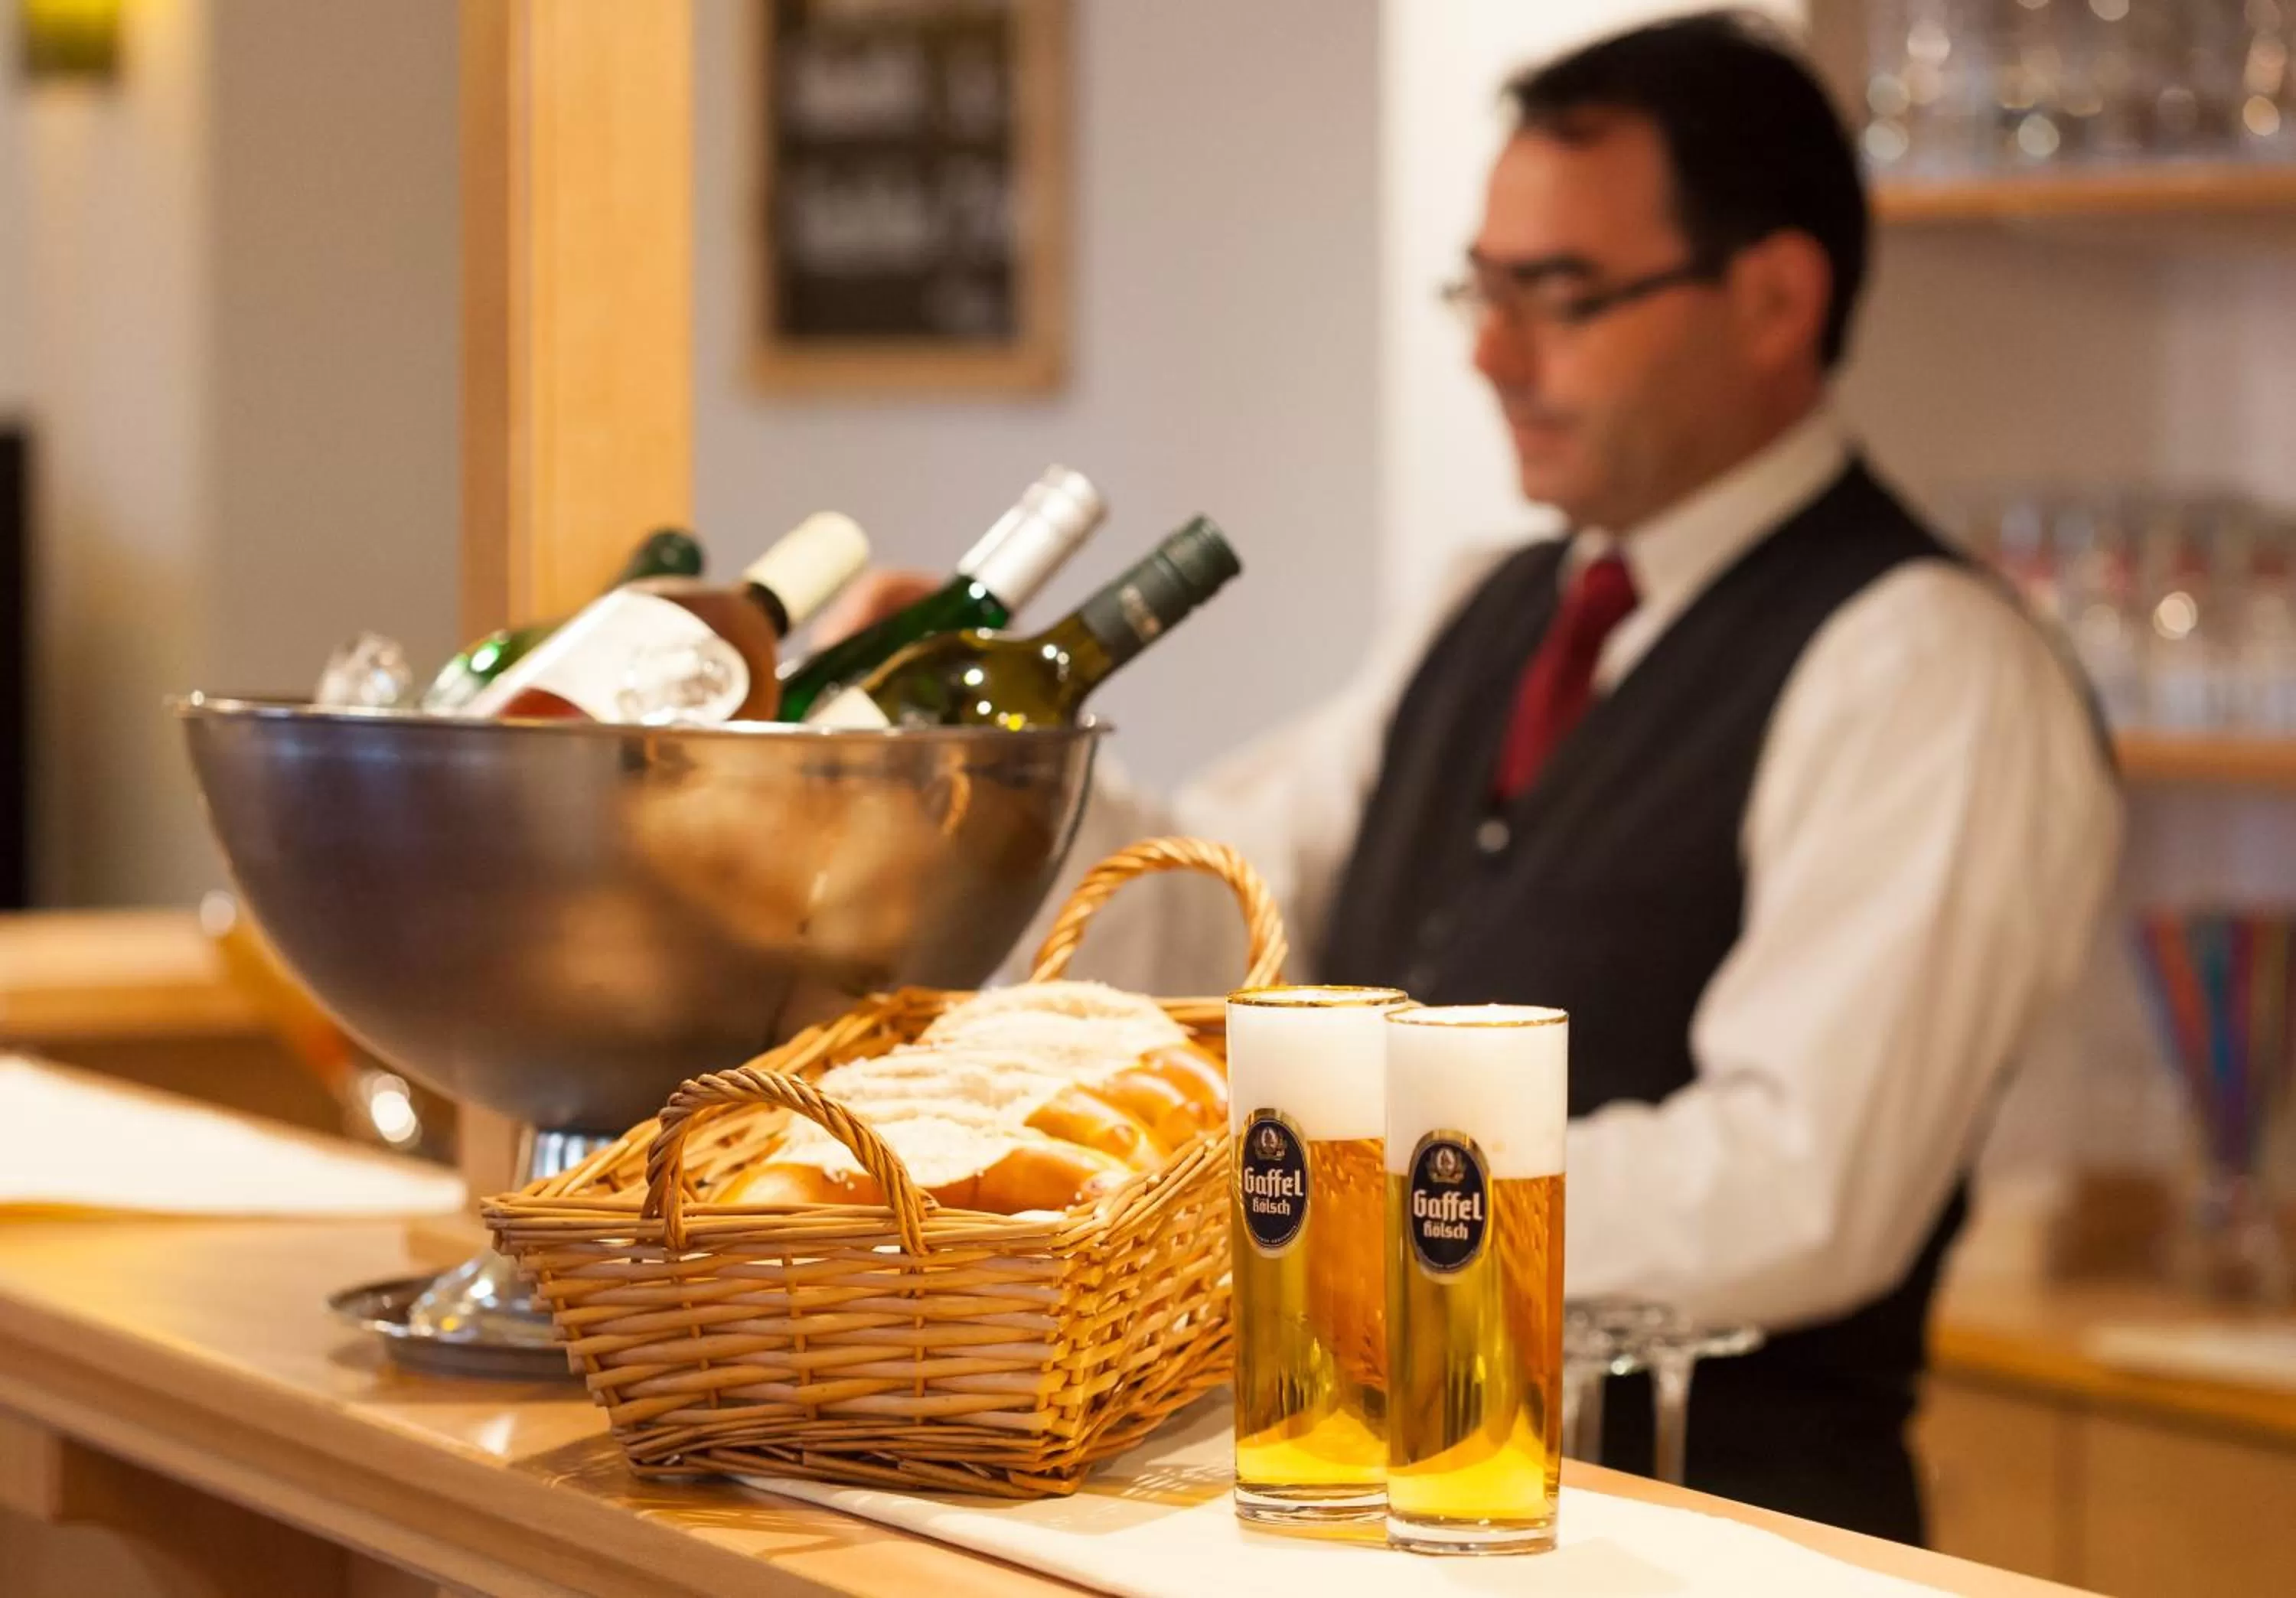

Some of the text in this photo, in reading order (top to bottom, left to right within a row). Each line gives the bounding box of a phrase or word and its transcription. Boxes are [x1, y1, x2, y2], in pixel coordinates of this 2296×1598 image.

[1244, 1166, 1303, 1198] Gaffel
[1253, 1197, 1291, 1216] Kölsch
[1414, 1189, 1483, 1221] Gaffel
[1424, 1220, 1469, 1240] Kölsch
